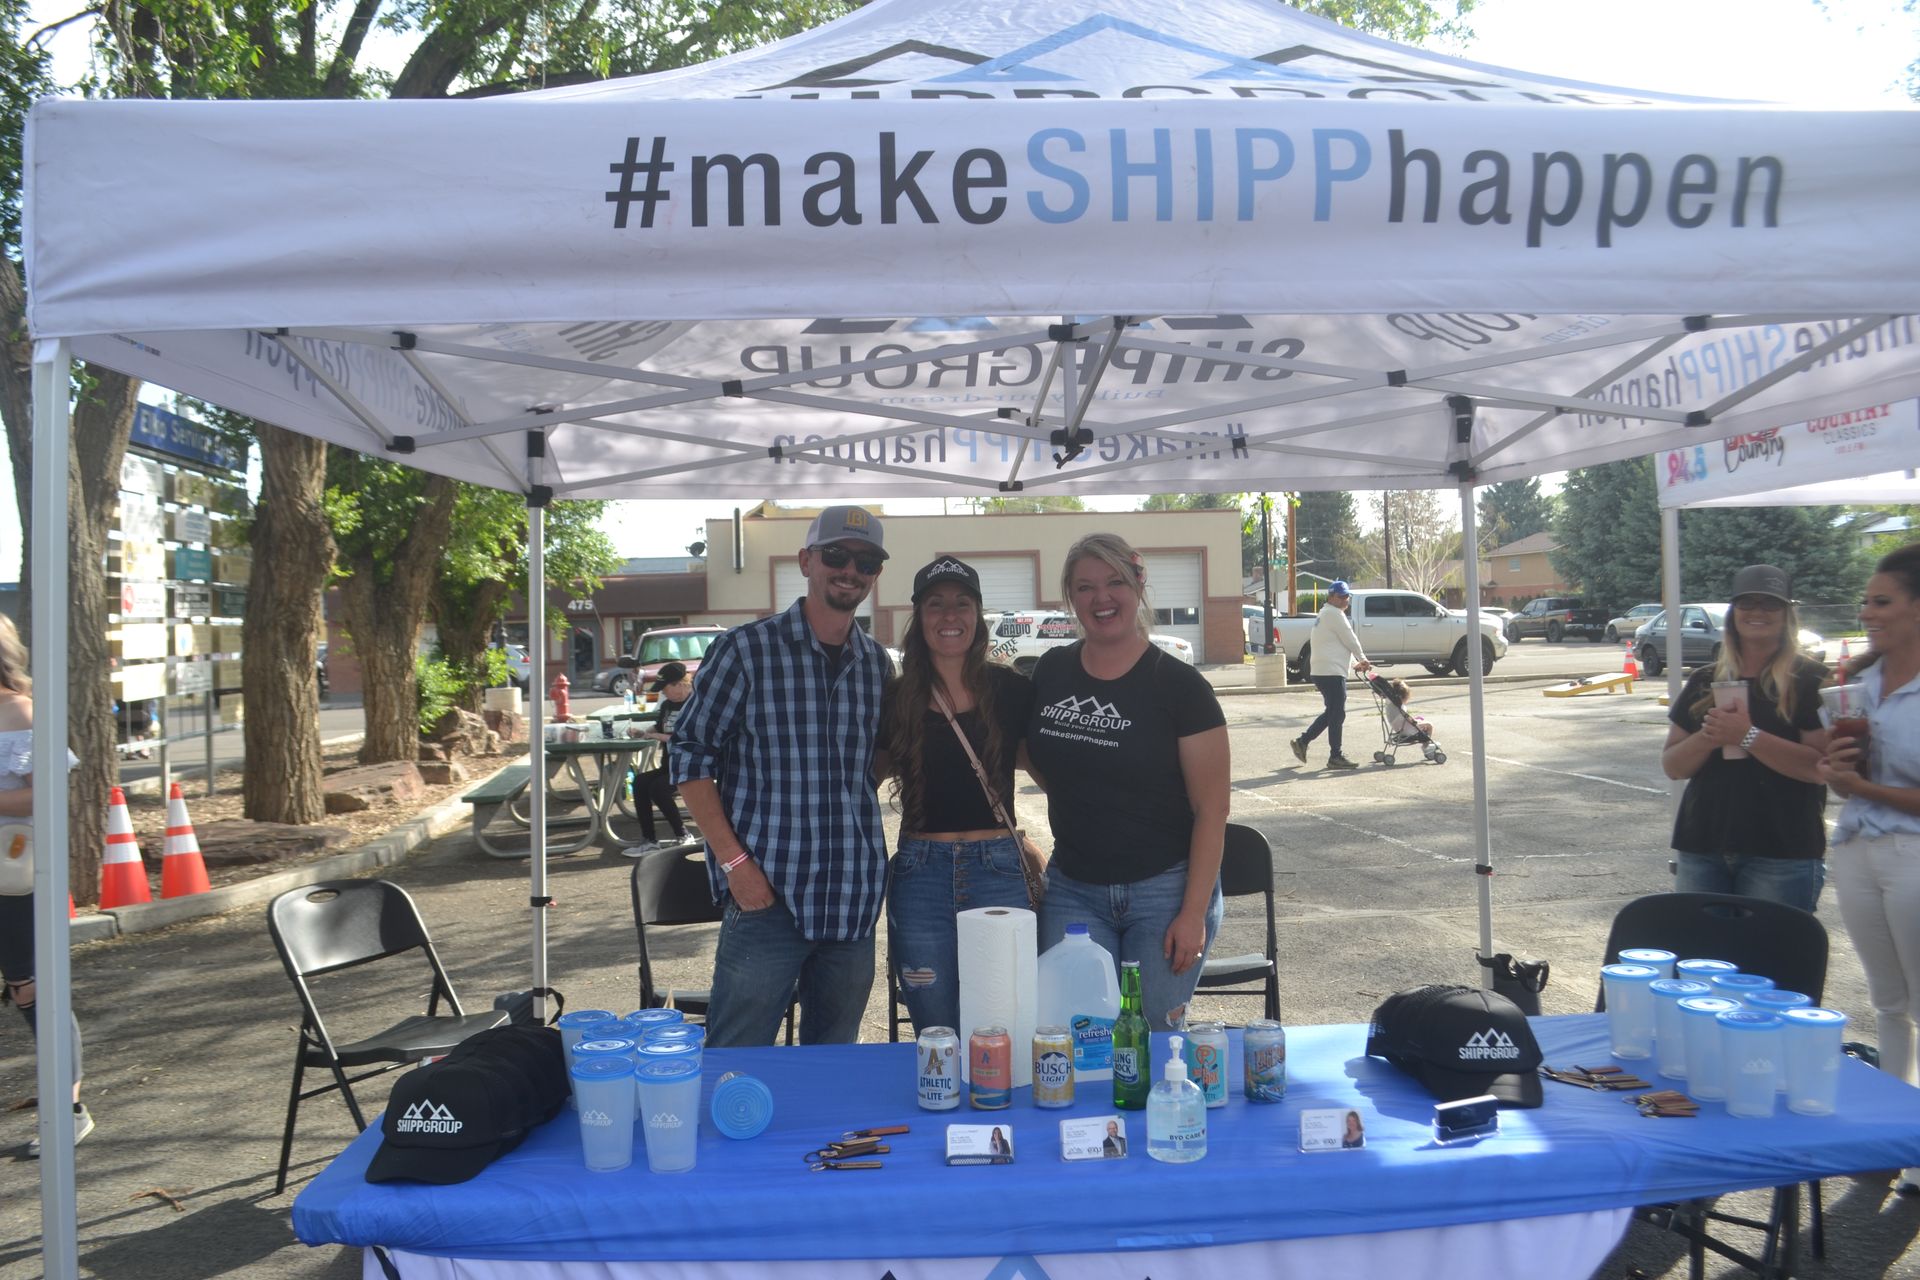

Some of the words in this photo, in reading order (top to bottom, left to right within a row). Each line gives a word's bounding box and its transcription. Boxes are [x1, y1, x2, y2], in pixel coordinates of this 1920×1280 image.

[604, 127, 1785, 249] #makeSHIPPhappen
[139, 408, 168, 440] Elko
[1823, 422, 1877, 445] CLASSICS
[567, 600, 593, 610] 475
[1003, 623, 1032, 636] RADIO
[1040, 705, 1132, 731] SHIPPGROUP
[1054, 720, 1070, 728] Build
[1039, 727, 1120, 748] #makeSHIPPhappen
[1458, 1046, 1521, 1060] SHIPPGROUP
[1034, 1060, 1072, 1075] BUSCH
[919, 1076, 952, 1091] ATHLETIC
[1041, 1075, 1066, 1083] LIGHT
[927, 1091, 944, 1101] LITE
[396, 1119, 463, 1134] SHIPPGROUP
[1185, 1132, 1201, 1140] CARE
